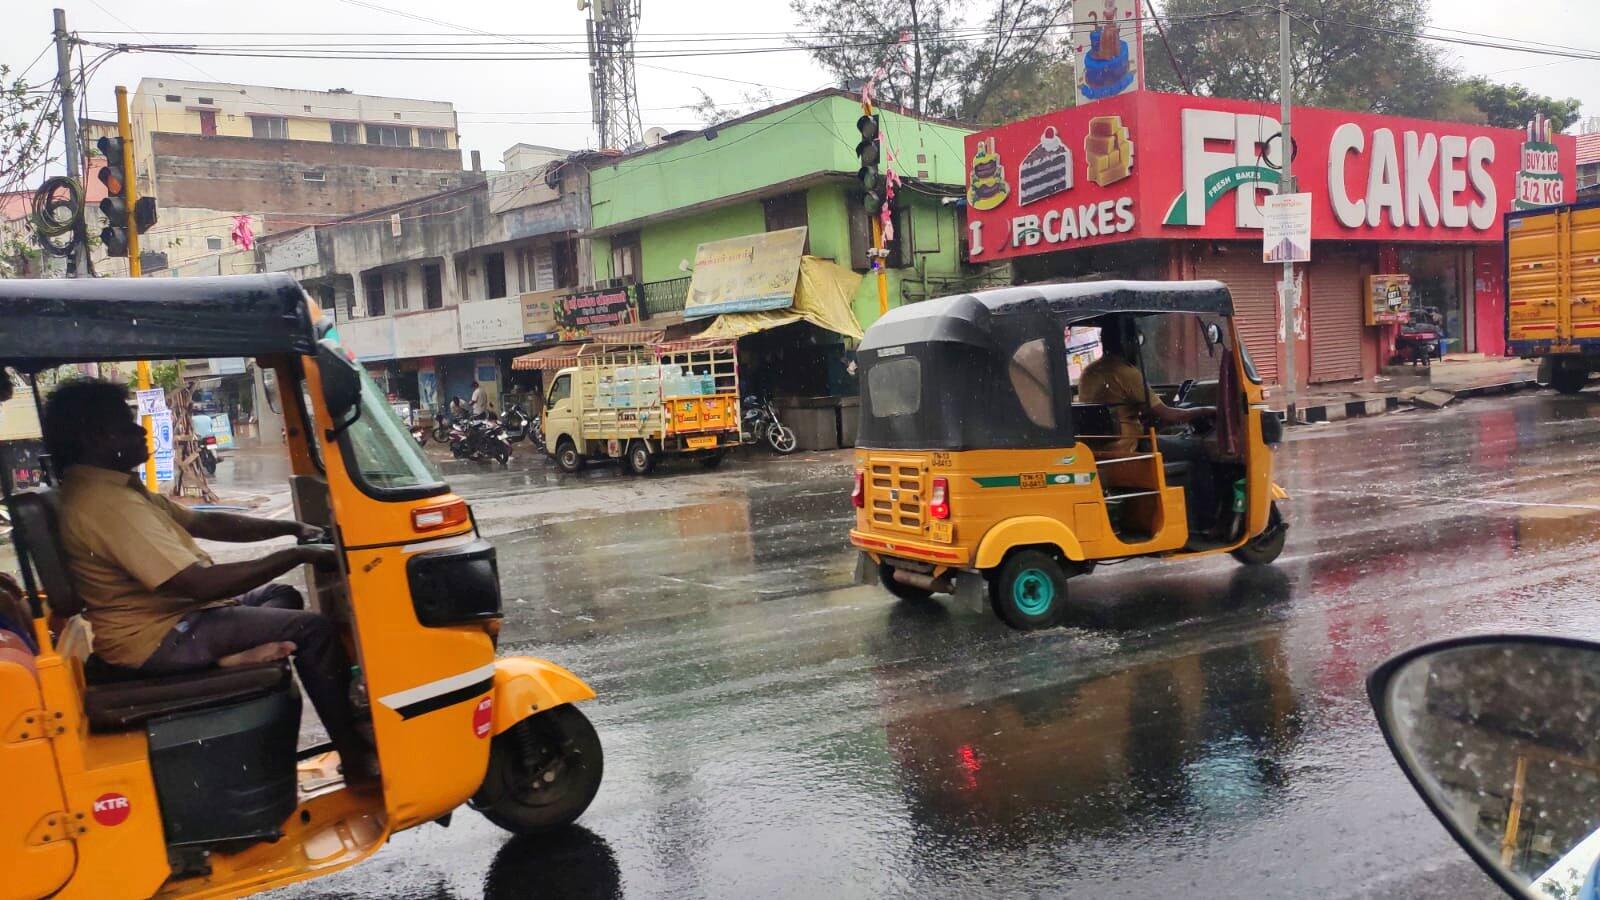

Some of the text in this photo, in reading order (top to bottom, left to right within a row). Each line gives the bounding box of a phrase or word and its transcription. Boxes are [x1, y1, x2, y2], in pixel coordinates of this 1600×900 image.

[1182, 109, 1497, 229] FB CAKES
[1526, 152, 1540, 170] BUY
[1547, 153, 1558, 171] KG
[1208, 171, 1261, 198] FRESH BAKES
[1522, 180, 1561, 204] 1/2 KG
[969, 221, 984, 256] I
[1043, 197, 1136, 243] CAKES
[94, 797, 129, 812] KTR
